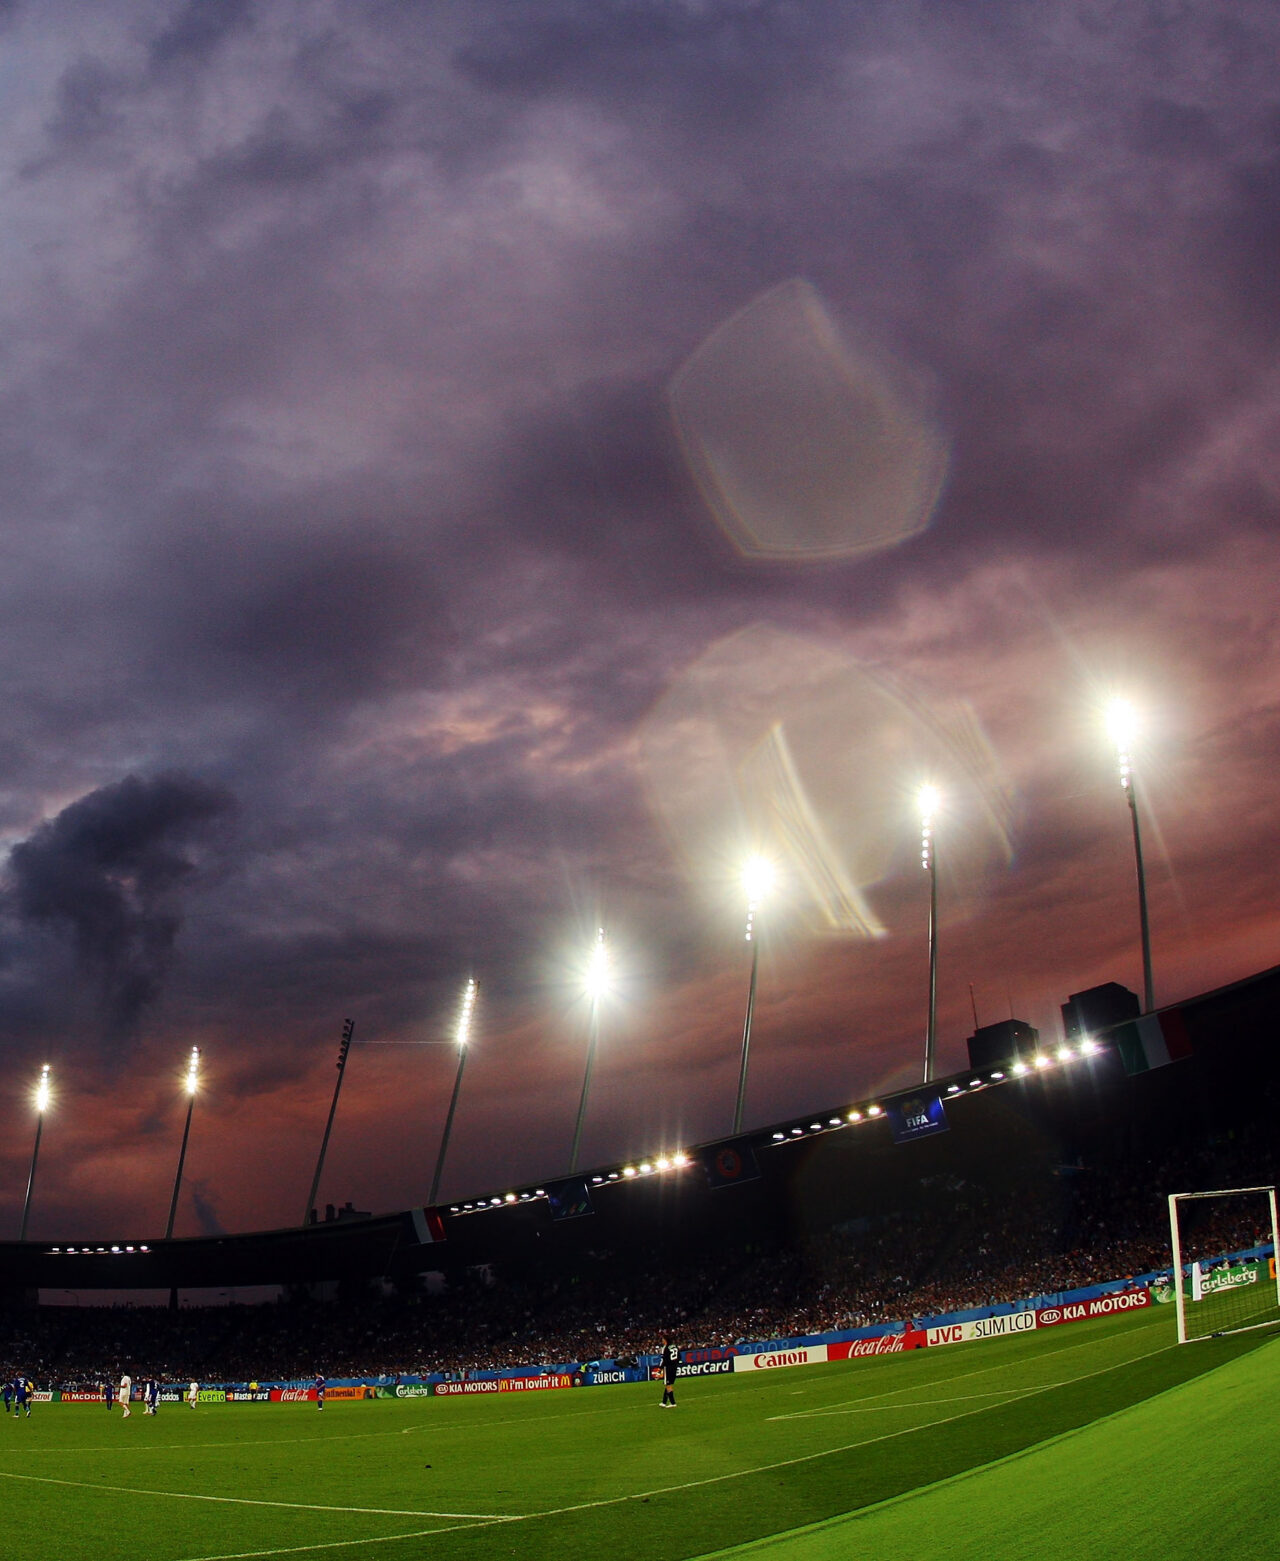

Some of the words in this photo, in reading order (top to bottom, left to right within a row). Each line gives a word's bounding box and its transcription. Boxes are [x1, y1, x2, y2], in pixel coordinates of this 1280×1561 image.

[906, 1114, 929, 1128] FIFA
[1043, 1312, 1058, 1321] KIA
[1063, 1304, 1086, 1320] KIA
[1089, 1291, 1147, 1315] MOTORS
[975, 1317, 1005, 1337] SLIM
[1009, 1313, 1034, 1332] LCD
[930, 1325, 962, 1344] JVC
[847, 1333, 906, 1359] Coca-Cola
[753, 1350, 808, 1369] Canon
[676, 1360, 730, 1377] asterCard
[19, 1380, 25, 1388] 2
[509, 1379, 524, 1390] i'm
[593, 1371, 626, 1384] ZÜRICH
[396, 1384, 428, 1398] Carlsberg
[449, 1383, 463, 1393] KIA
[464, 1380, 498, 1392] MOTORS
[198, 1392, 224, 1401] Everio
